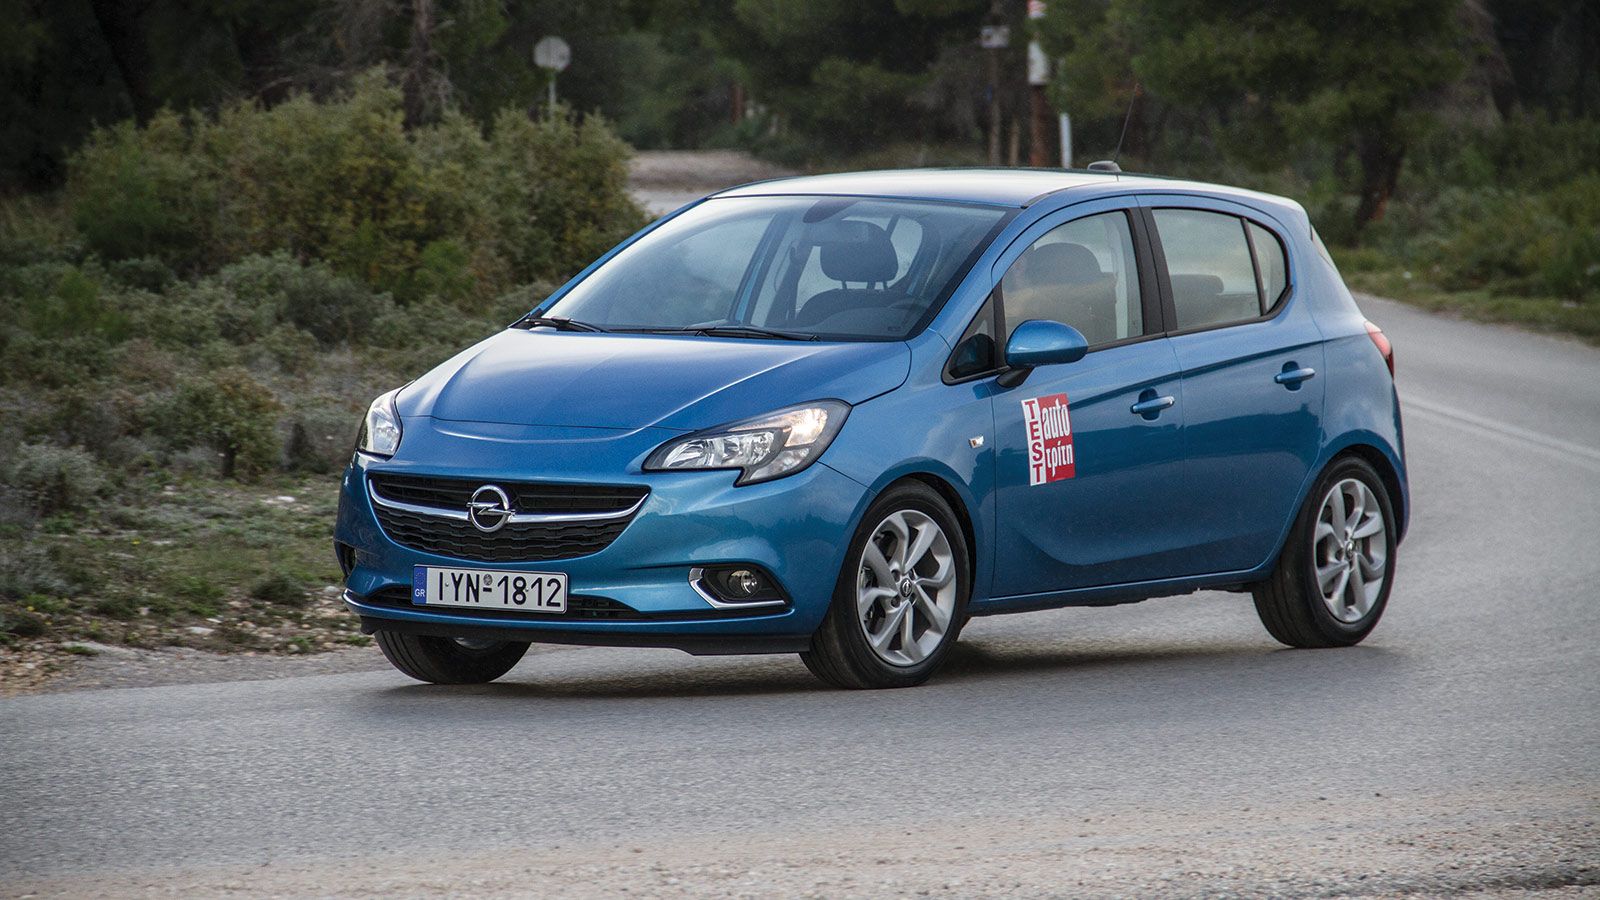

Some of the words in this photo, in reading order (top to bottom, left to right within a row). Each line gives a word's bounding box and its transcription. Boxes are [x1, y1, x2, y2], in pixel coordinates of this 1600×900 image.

[1042, 398, 1071, 440] auto
[1024, 400, 1043, 483] TEST
[414, 588, 426, 597] GR
